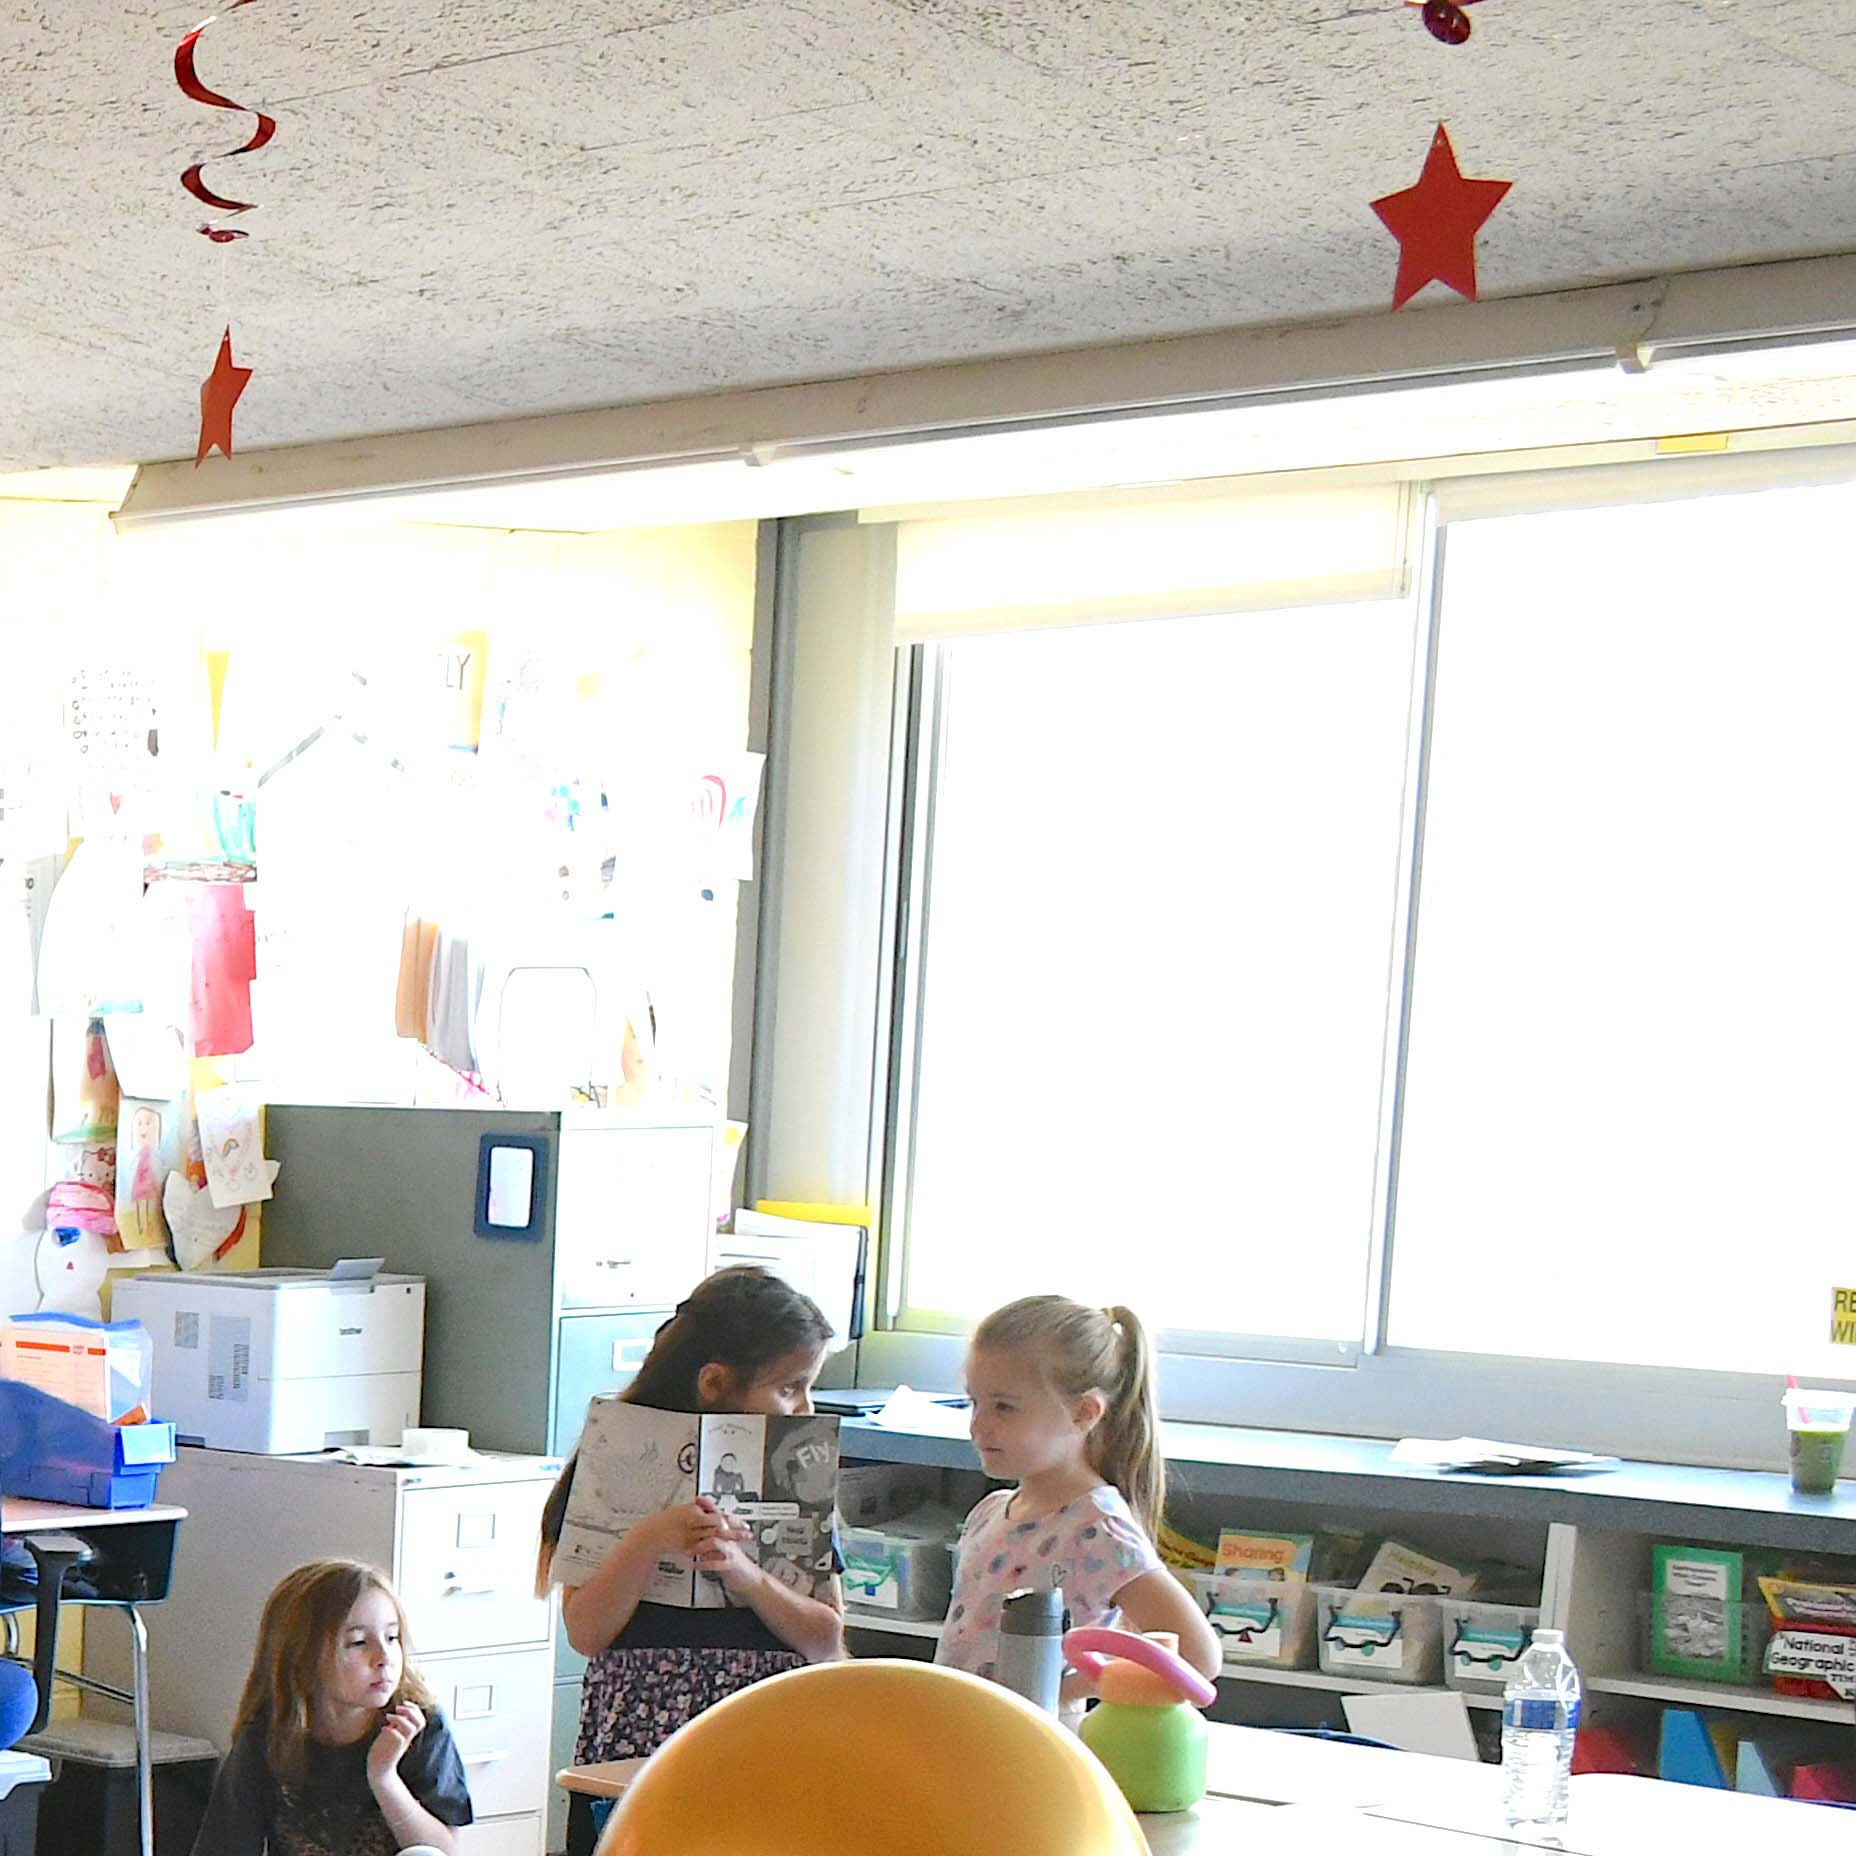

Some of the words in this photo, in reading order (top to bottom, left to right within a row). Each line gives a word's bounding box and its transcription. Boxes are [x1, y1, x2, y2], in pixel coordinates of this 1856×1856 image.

[795, 1441, 832, 1469] Fly
[1783, 1637, 1845, 1655] National
[1772, 1652, 1856, 1673] Geographic
